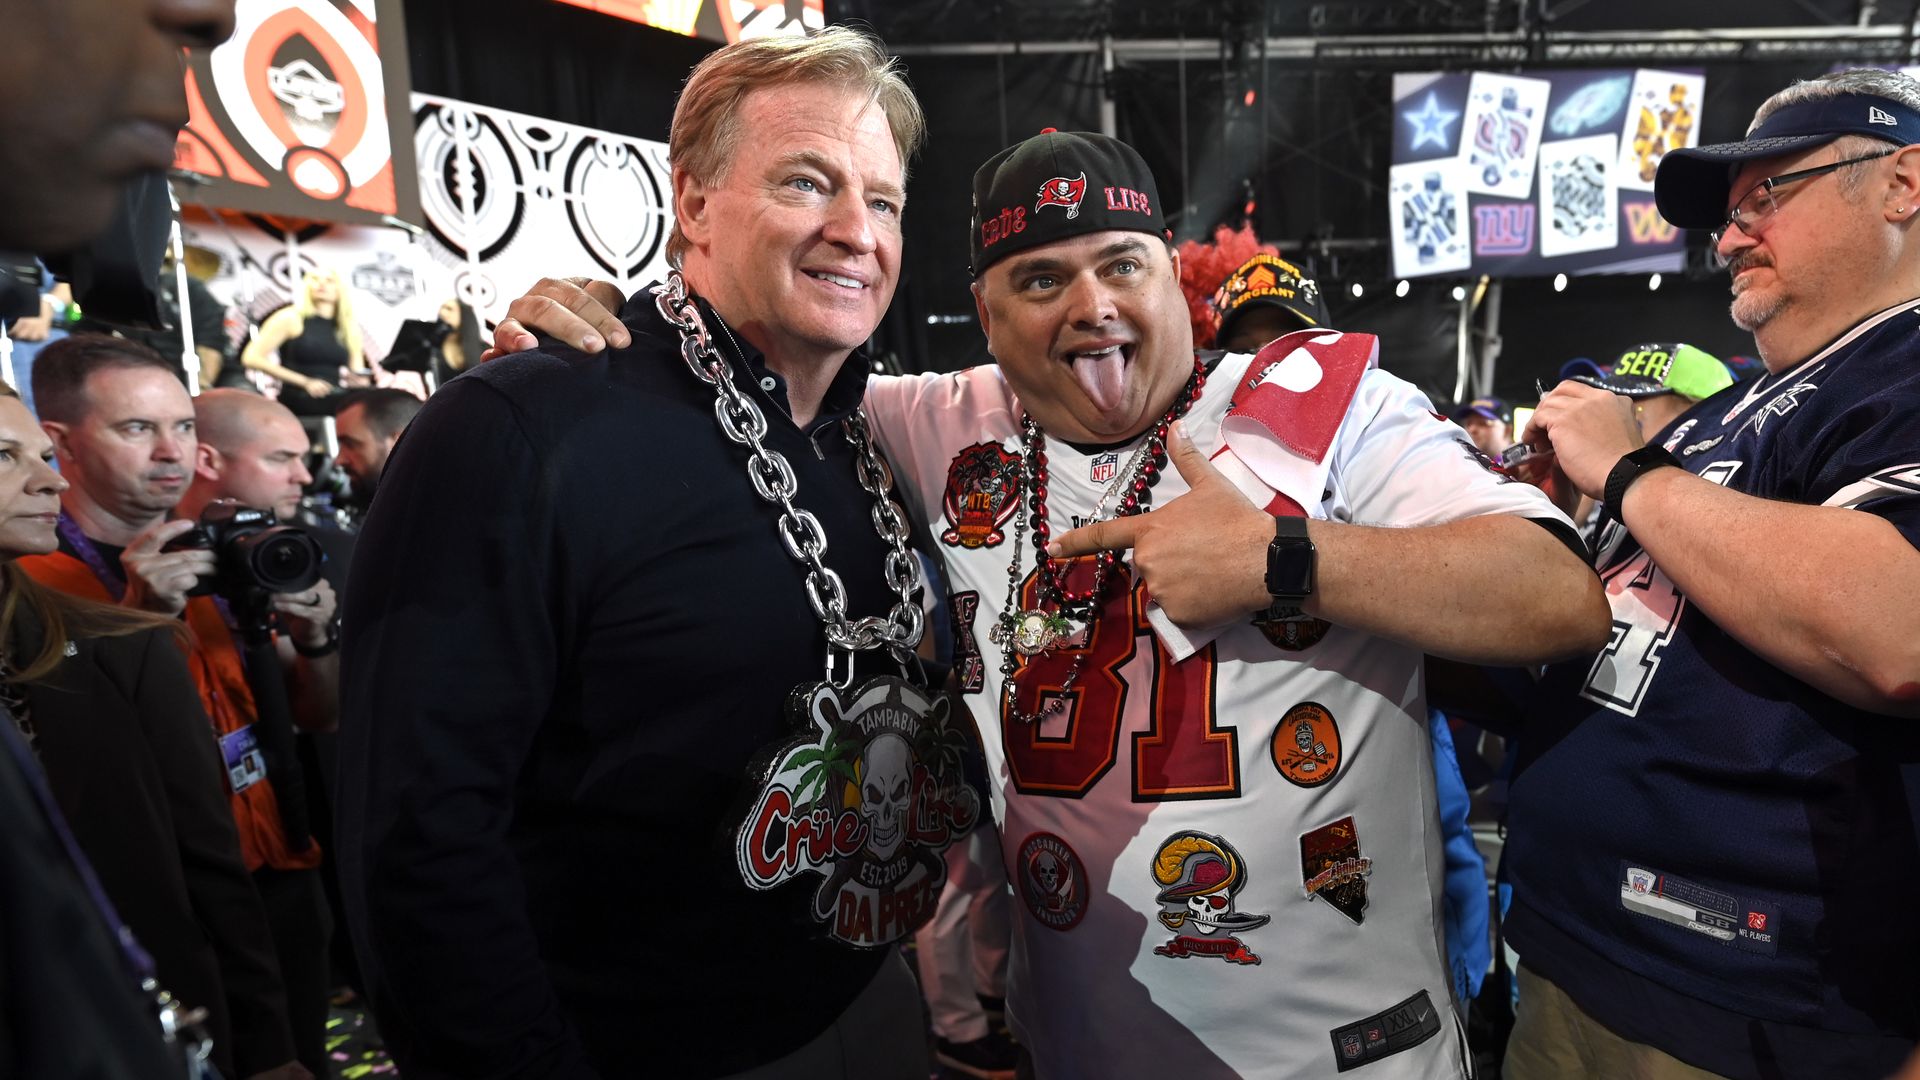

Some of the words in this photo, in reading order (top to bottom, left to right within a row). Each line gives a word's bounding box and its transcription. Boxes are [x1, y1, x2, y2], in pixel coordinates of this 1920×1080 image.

[1104, 186, 1151, 216] LIFE
[1231, 286, 1295, 308] SERGEANT
[1615, 352, 1668, 378] SEA
[1092, 464, 1114, 480] NFL
[1001, 553, 1241, 802] 81
[750, 788, 868, 880] Crüe
[1634, 883, 1647, 893] NFL
[838, 889, 873, 942] DA
[1701, 914, 1730, 929] 58
[1739, 928, 1748, 938] NFL
[1749, 931, 1771, 943] PLAYERS
[1388, 1008, 1414, 1032] XXL
[1343, 1044, 1360, 1056] NFL
